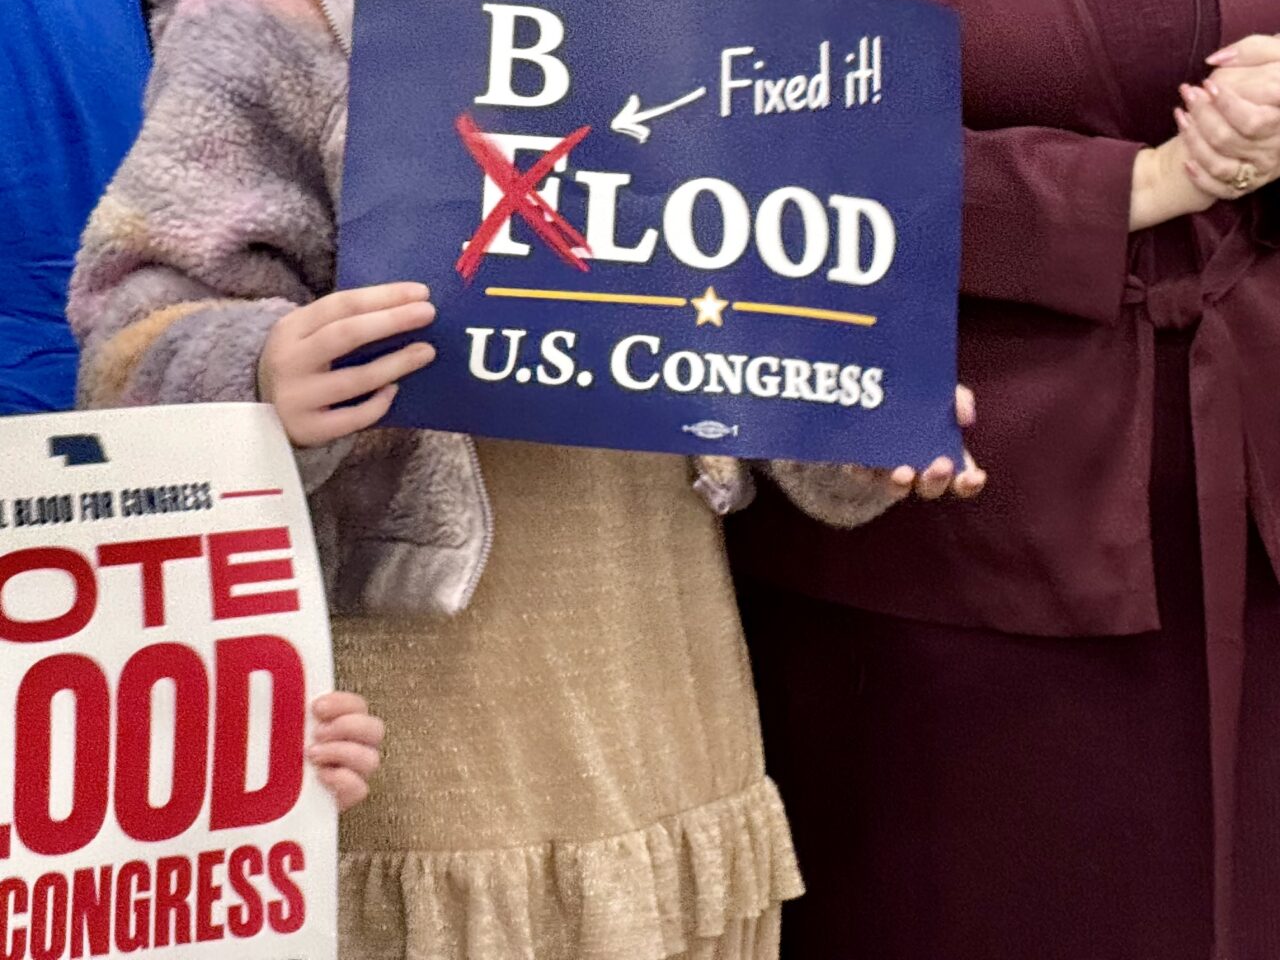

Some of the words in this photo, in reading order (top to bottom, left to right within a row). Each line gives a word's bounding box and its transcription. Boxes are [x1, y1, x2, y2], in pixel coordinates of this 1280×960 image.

[474, 2, 570, 107] B
[720, 39, 830, 117] Fixed
[845, 36, 882, 108] it!
[464, 326, 593, 388] U.S.
[610, 334, 884, 409] CONGRESS
[14, 494, 72, 527] BLOOD
[80, 491, 114, 522] FOR
[121, 481, 213, 517] CONGRESS
[0, 840, 306, 960] CONGRESS
